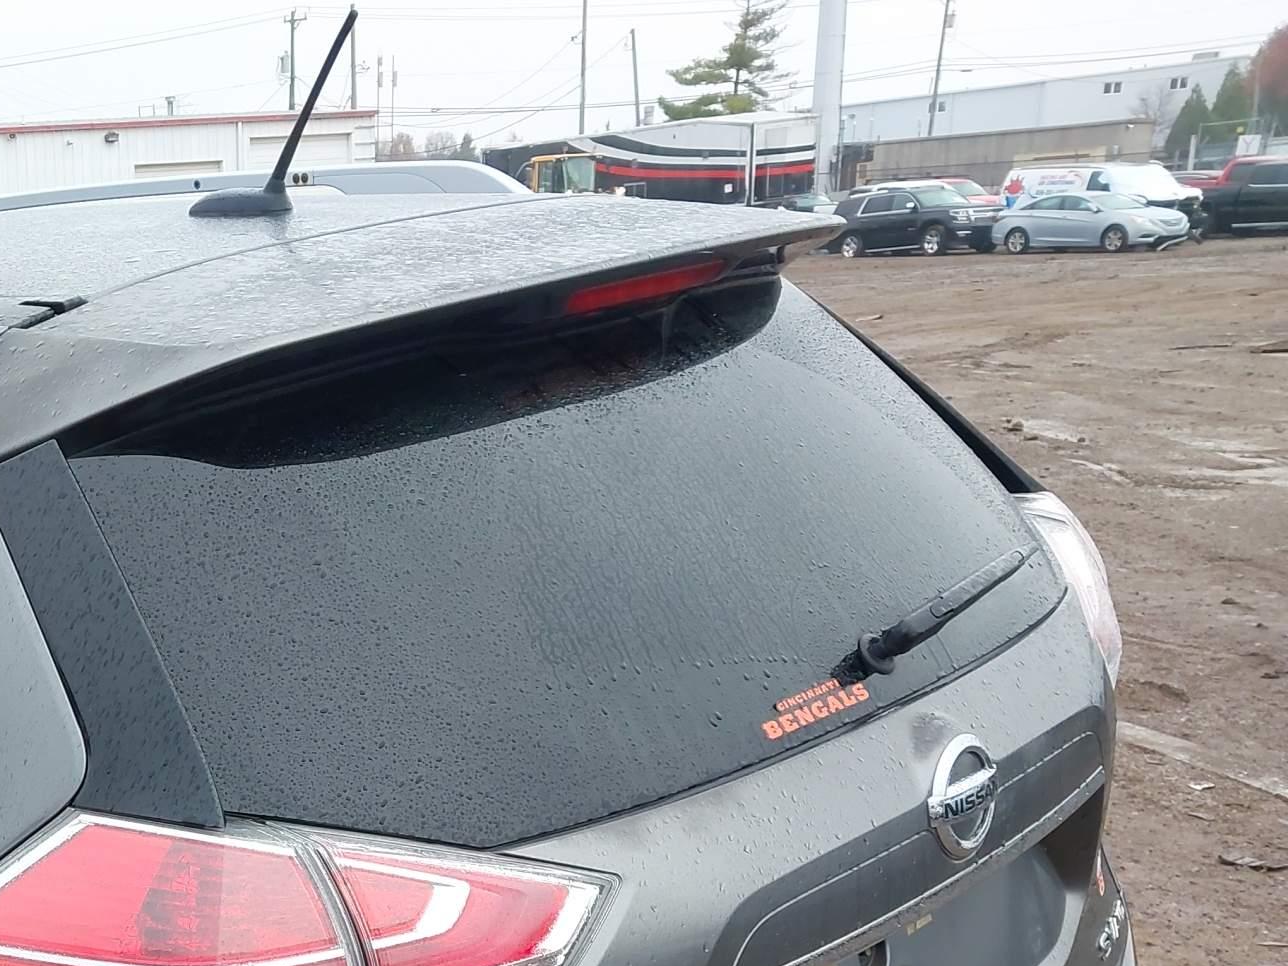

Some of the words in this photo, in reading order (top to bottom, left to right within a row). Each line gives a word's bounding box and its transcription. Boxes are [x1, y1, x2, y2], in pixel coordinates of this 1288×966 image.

[761, 682, 870, 740] BENGALS
[774, 678, 840, 712] CINCINNATI
[943, 780, 998, 819] NISSAN
